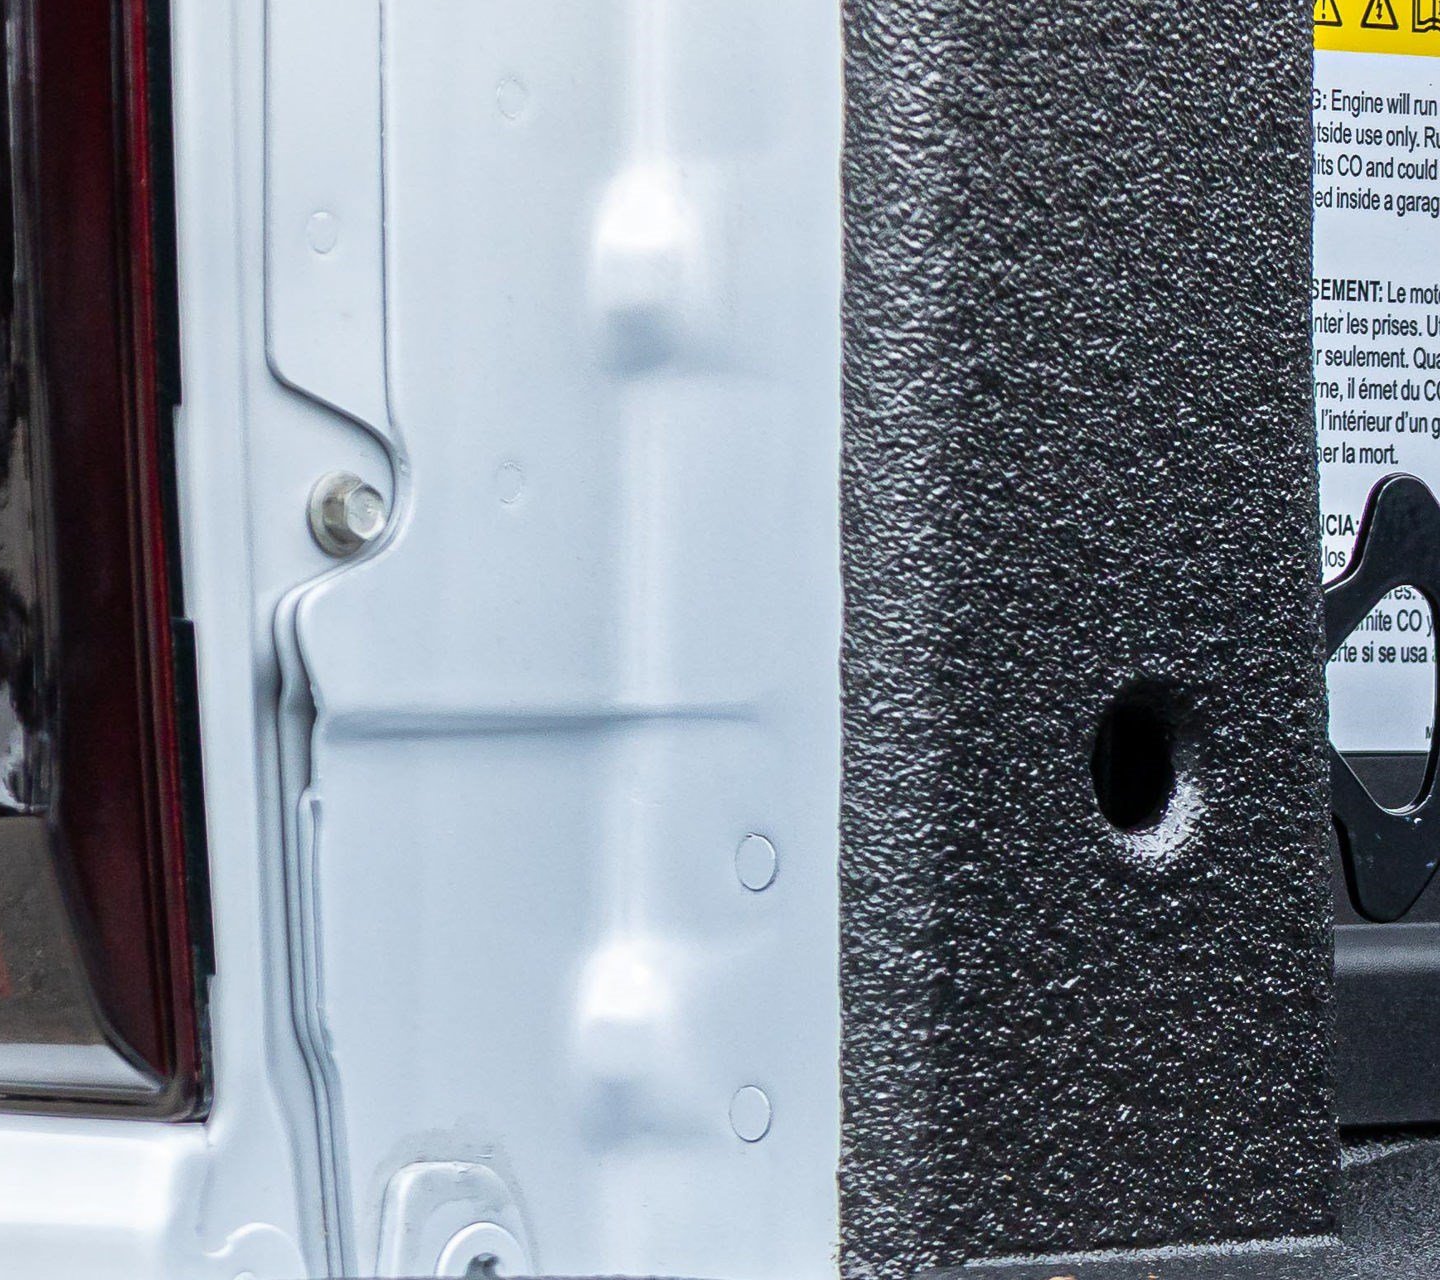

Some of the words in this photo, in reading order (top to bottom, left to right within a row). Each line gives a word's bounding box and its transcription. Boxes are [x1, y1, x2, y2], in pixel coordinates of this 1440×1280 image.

[1331, 89, 1384, 118] Engine
[1386, 93, 1410, 115] will
[1413, 99, 1438, 117] run
[1313, 121, 1352, 144] tside
[1355, 128, 1383, 146] use
[1385, 125, 1420, 153] only.
[1313, 154, 1334, 176] its
[1337, 154, 1363, 178] CO
[1365, 157, 1394, 179] and
[1397, 158, 1438, 181] could
[1314, 186, 1333, 209] ed
[1336, 187, 1381, 211] inside
[1383, 193, 1394, 211] a
[1387, 281, 1407, 304] Le
[1314, 312, 1344, 334] nter
[1346, 312, 1369, 335] les
[1372, 313, 1422, 341] prises.
[1324, 345, 1409, 369] seulement.
[1347, 377, 1355, 399] il
[1358, 377, 1399, 401] émet
[1400, 379, 1420, 401] du
[1342, 441, 1356, 464] la
[1359, 444, 1399, 465] mort.
[1324, 546, 1346, 568] los
[1396, 608, 1422, 632] CO
[1361, 641, 1374, 663] si
[1378, 646, 1396, 663] se
[1400, 646, 1427, 664] usa
